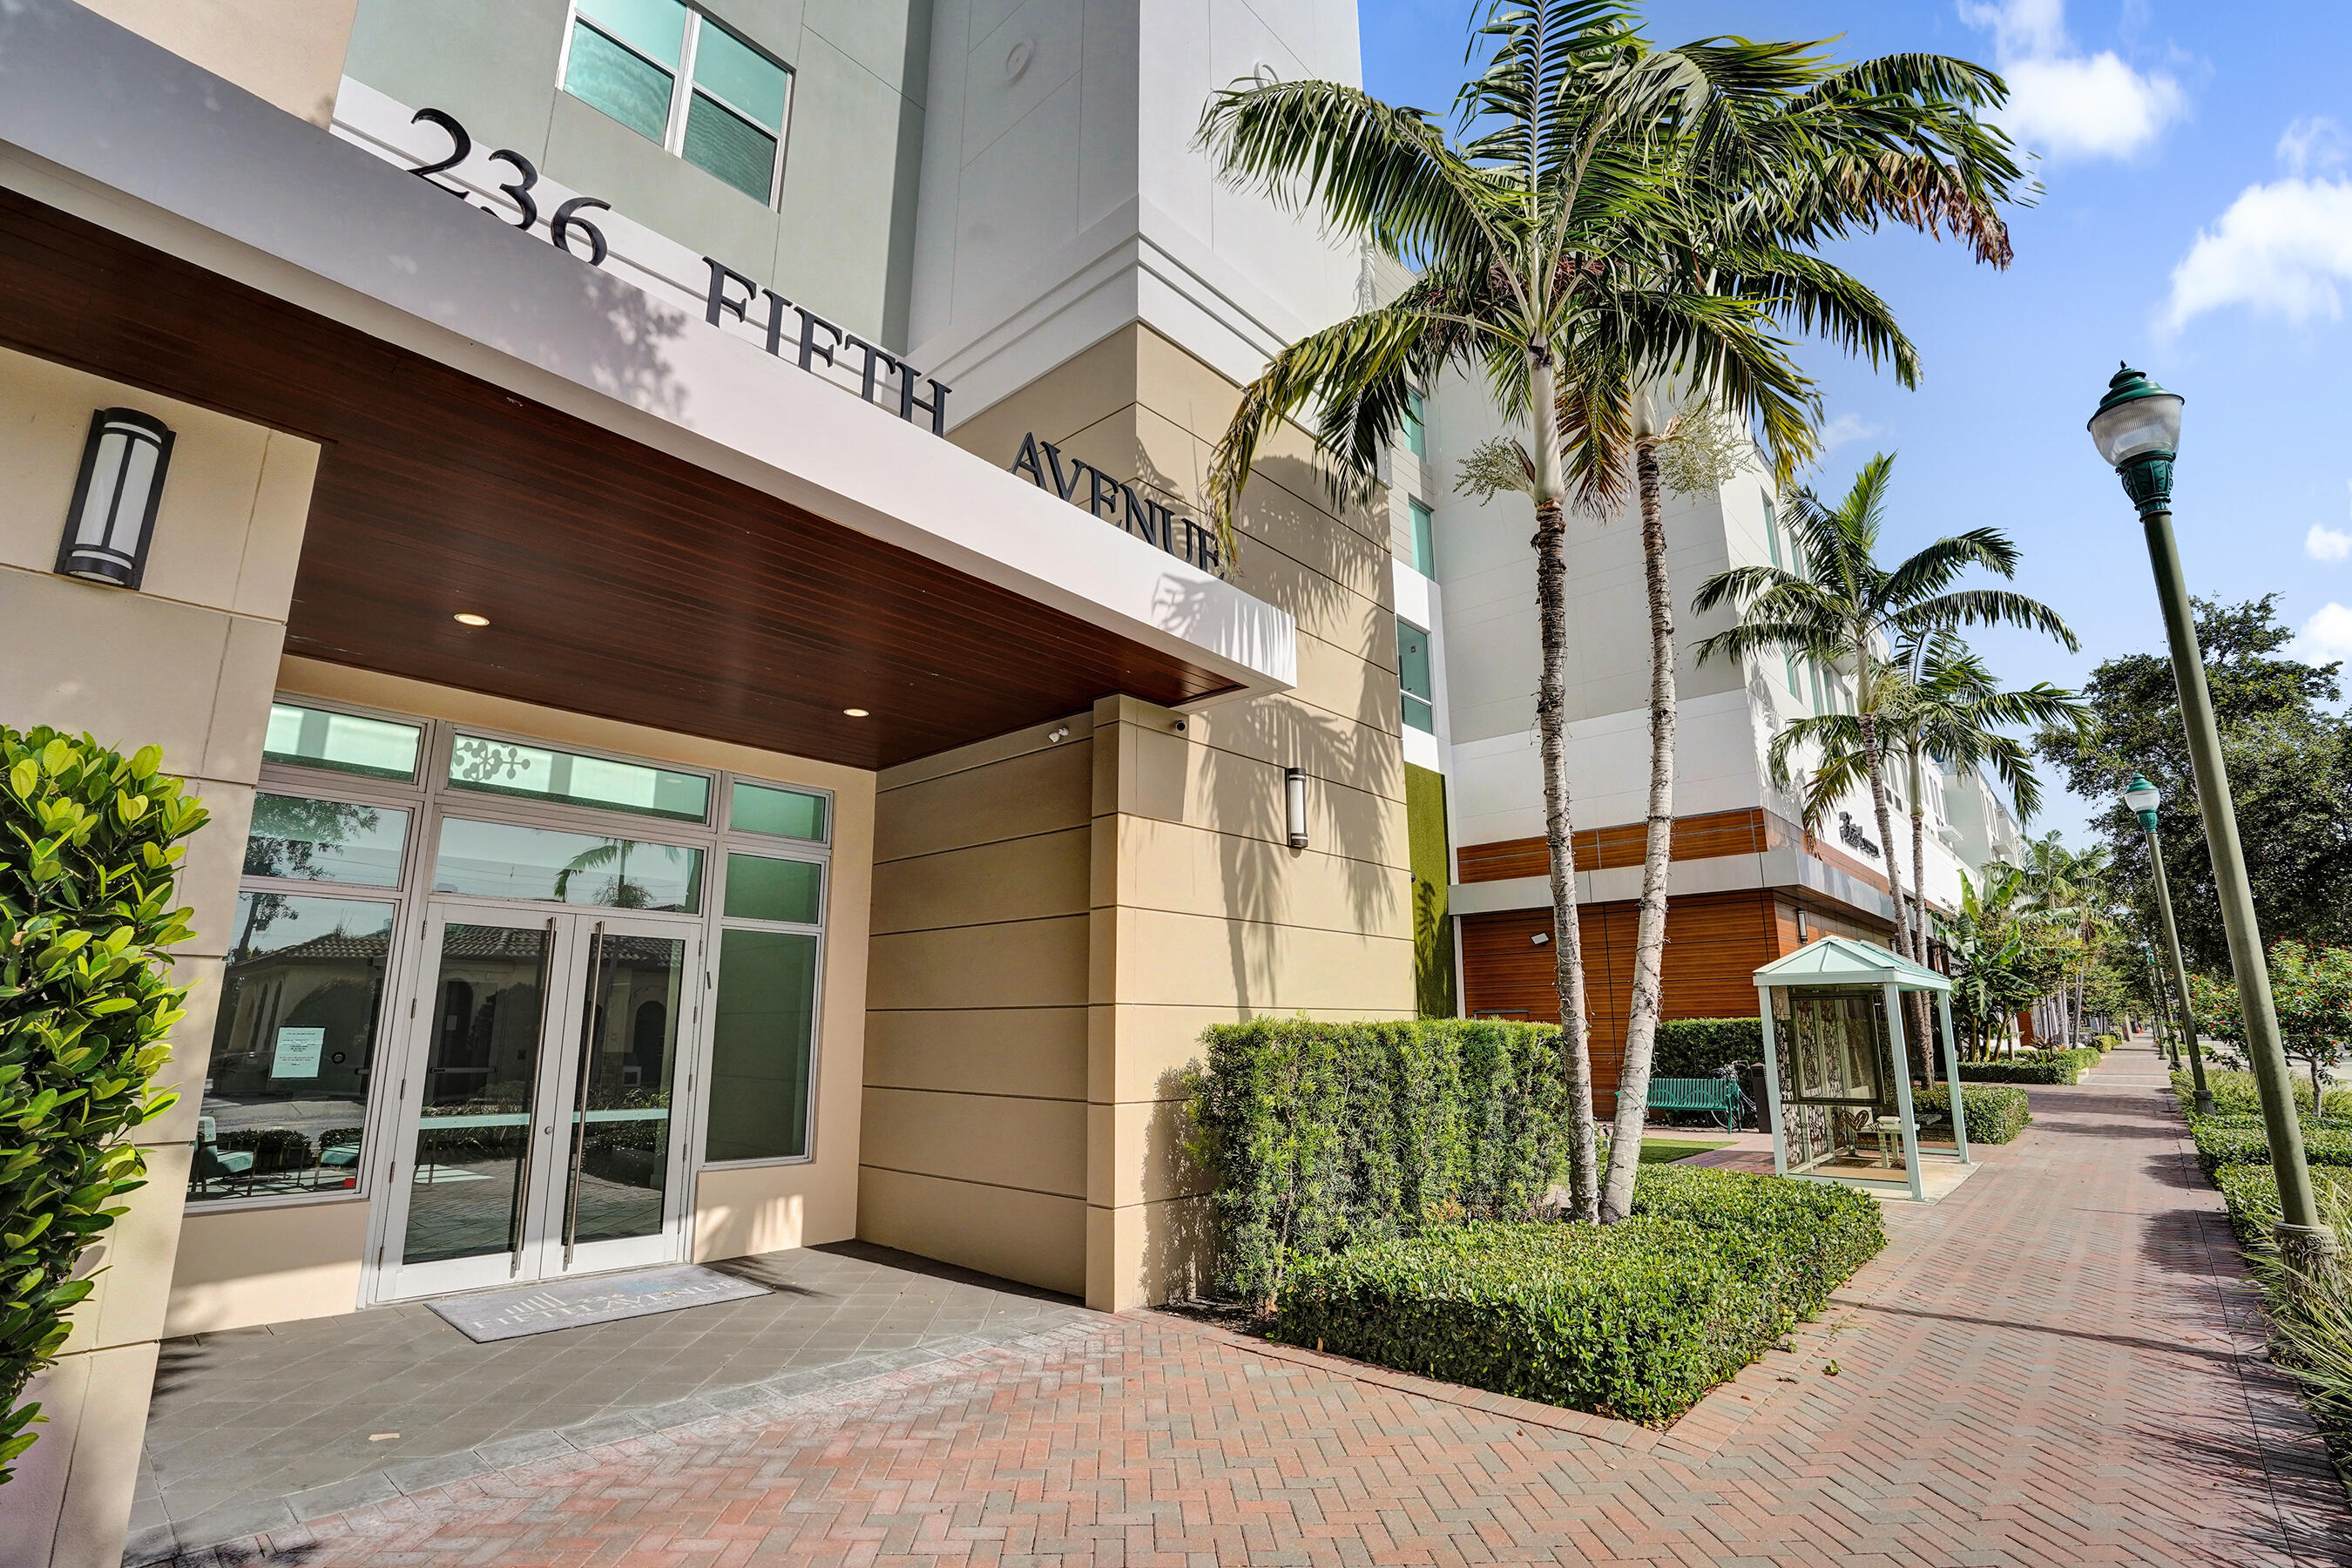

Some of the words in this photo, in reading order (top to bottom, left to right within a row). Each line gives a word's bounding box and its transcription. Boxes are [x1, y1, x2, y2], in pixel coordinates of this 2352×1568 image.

[407, 108, 612, 267] 236
[703, 256, 952, 437] FIFTH
[1010, 432, 1225, 581] AVENUE
[473, 1305, 592, 1329] FIFTH
[606, 1281, 743, 1309] AVENUE
